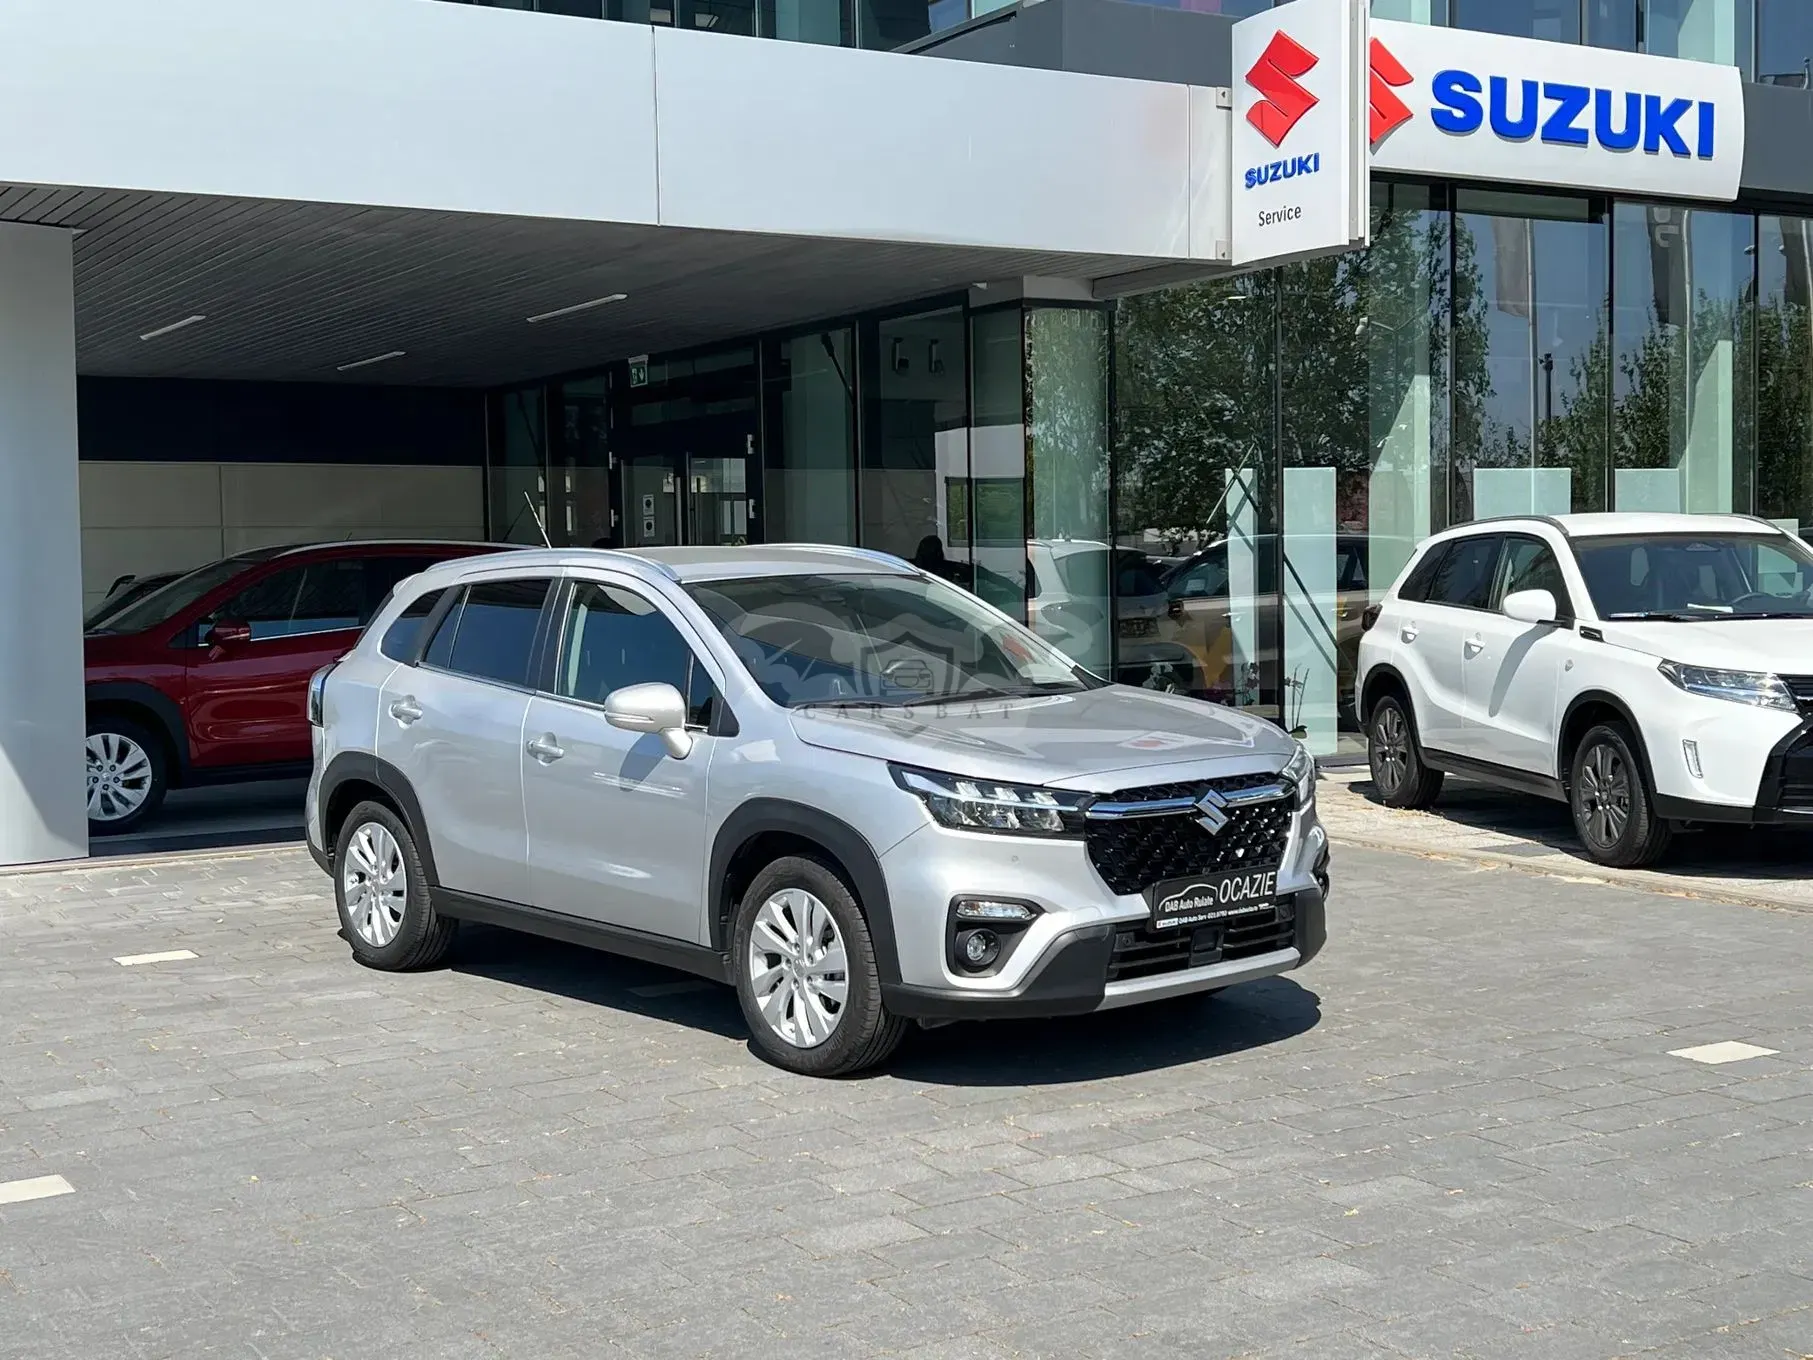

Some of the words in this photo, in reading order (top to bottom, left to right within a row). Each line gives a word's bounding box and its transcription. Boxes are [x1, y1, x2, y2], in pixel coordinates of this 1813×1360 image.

[1431, 69, 1715, 160] SUZUKI
[1245, 152, 1320, 189] SUZUKI
[1258, 205, 1302, 227] Service
[1219, 871, 1276, 903] OCAZIE
[1164, 900, 1179, 912] DAB
[1179, 898, 1194, 910] Auto
